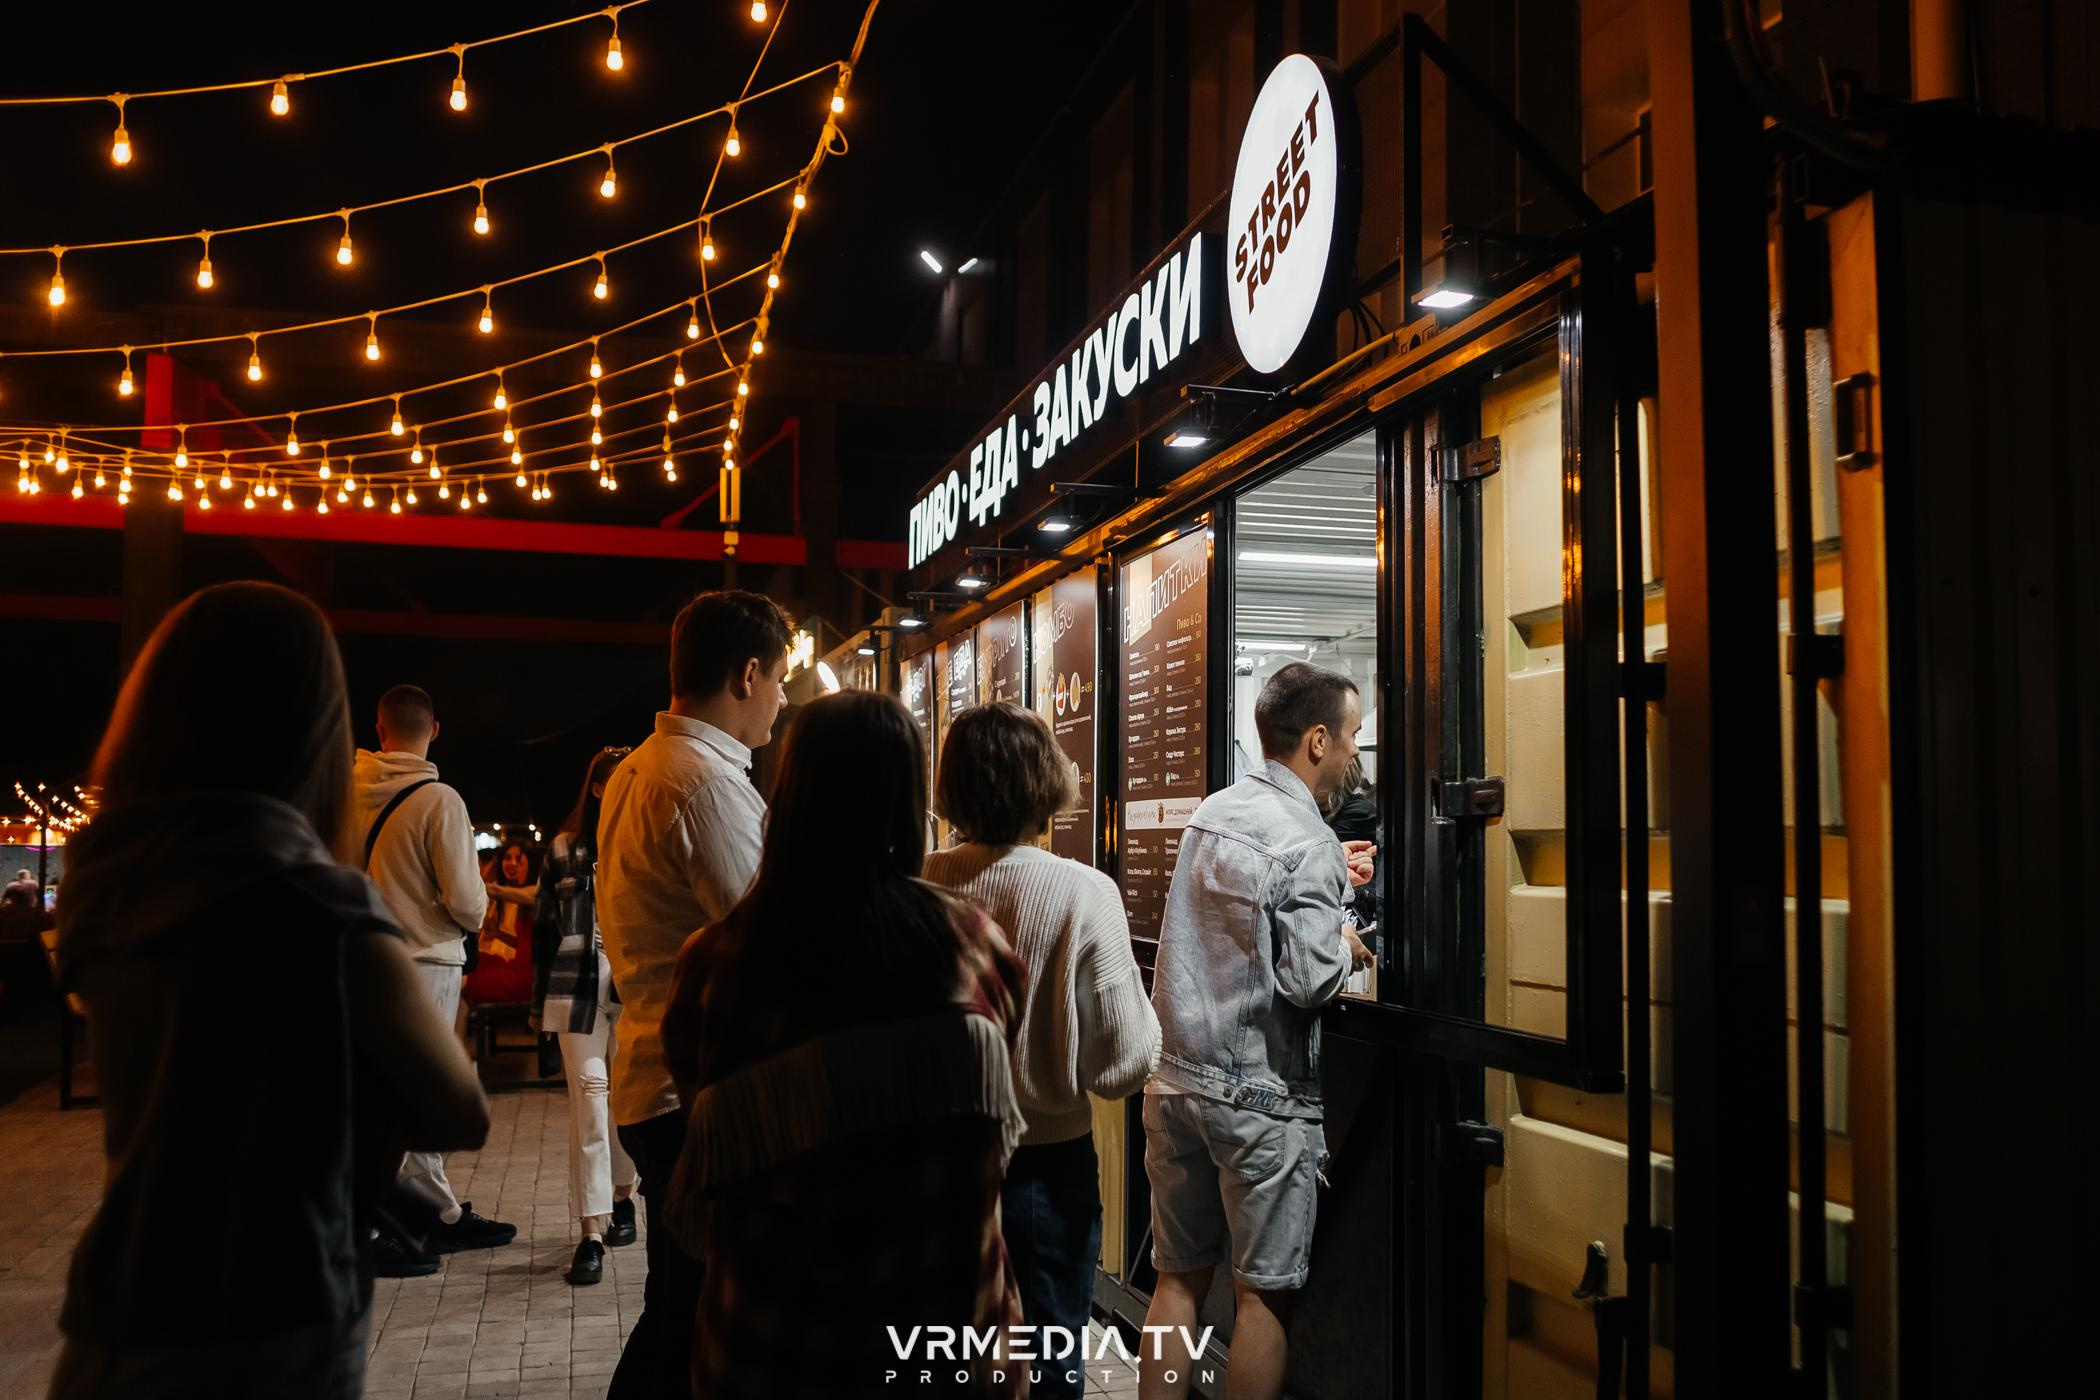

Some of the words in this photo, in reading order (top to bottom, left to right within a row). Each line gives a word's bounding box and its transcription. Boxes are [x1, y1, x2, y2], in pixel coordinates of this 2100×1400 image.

[1234, 88, 1320, 284] STREET
[1246, 169, 1312, 316] FOOD
[908, 470, 960, 571] ПИВО
[969, 414, 1019, 528] ЕДА
[1032, 231, 1202, 470] ЗАКУСКИ
